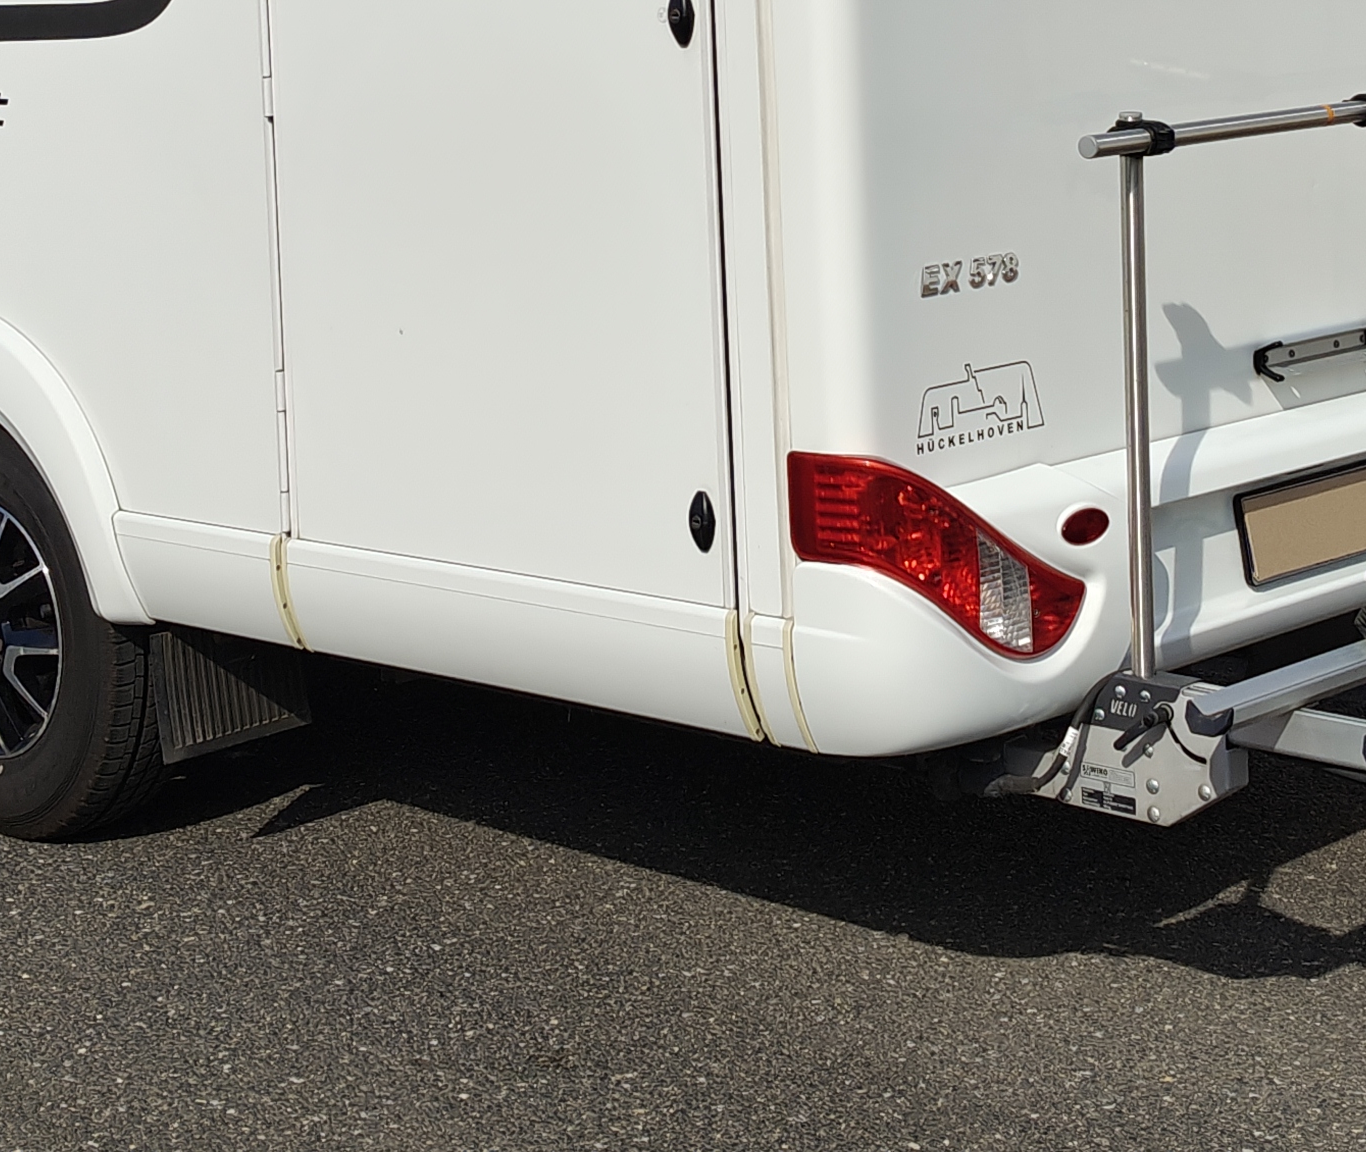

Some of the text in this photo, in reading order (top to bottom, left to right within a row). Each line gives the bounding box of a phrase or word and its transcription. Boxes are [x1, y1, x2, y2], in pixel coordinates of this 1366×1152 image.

[921, 252, 1019, 298] EX 578
[916, 420, 1024, 455] HÜCKELHOVEN
